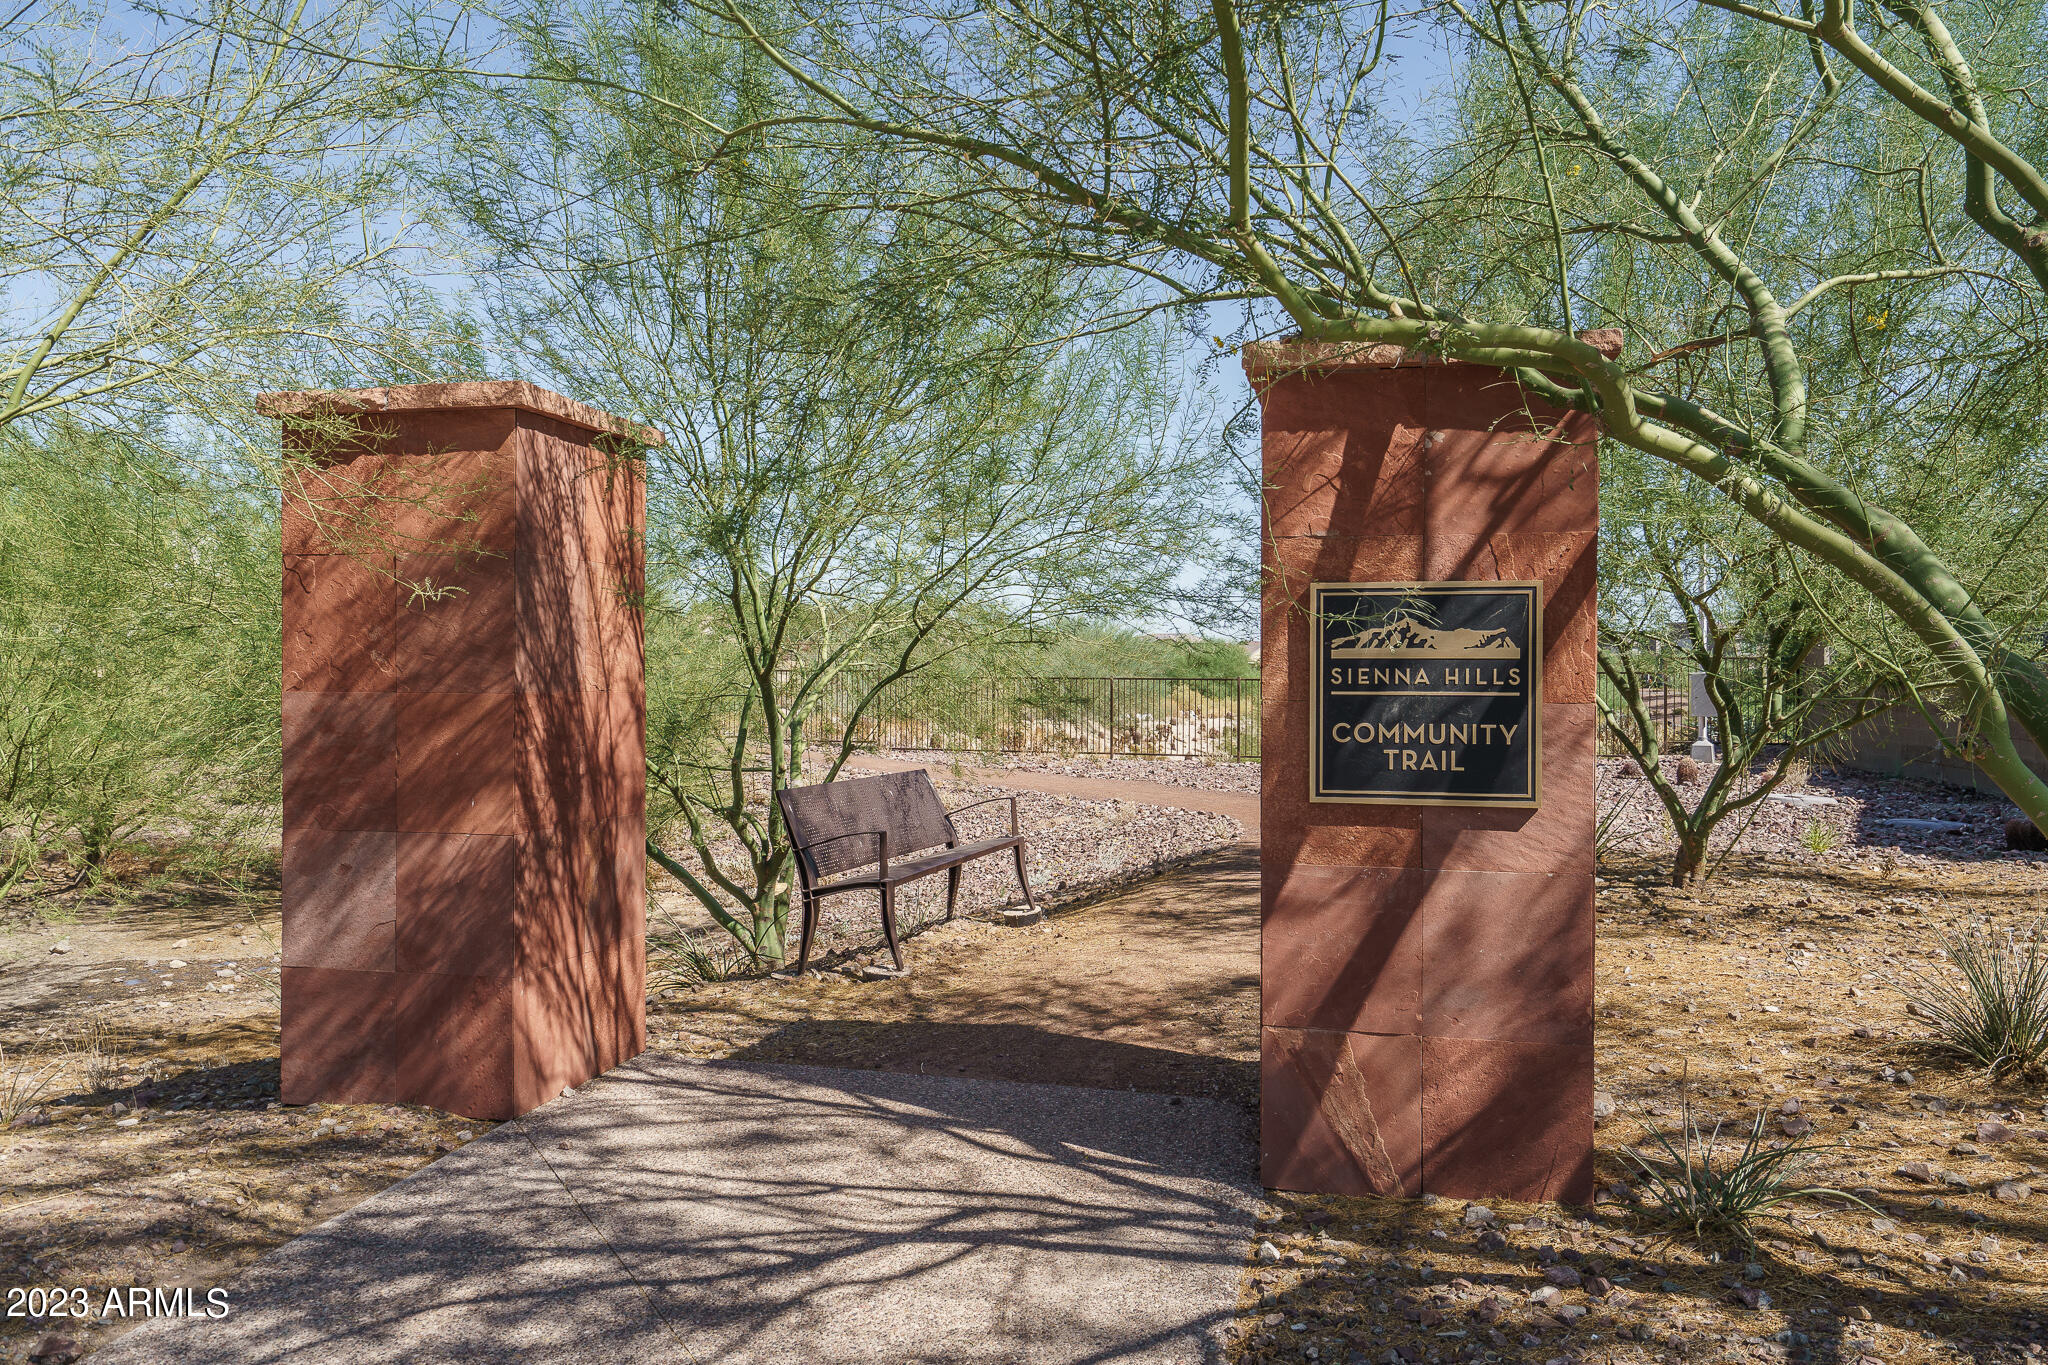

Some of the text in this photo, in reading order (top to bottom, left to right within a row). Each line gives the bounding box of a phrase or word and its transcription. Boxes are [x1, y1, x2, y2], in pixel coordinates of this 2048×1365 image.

[1330, 667, 1521, 686] SIENNA HILLS
[1332, 722, 1518, 745] COMMUNITY
[1383, 749, 1465, 771] TRAIL
